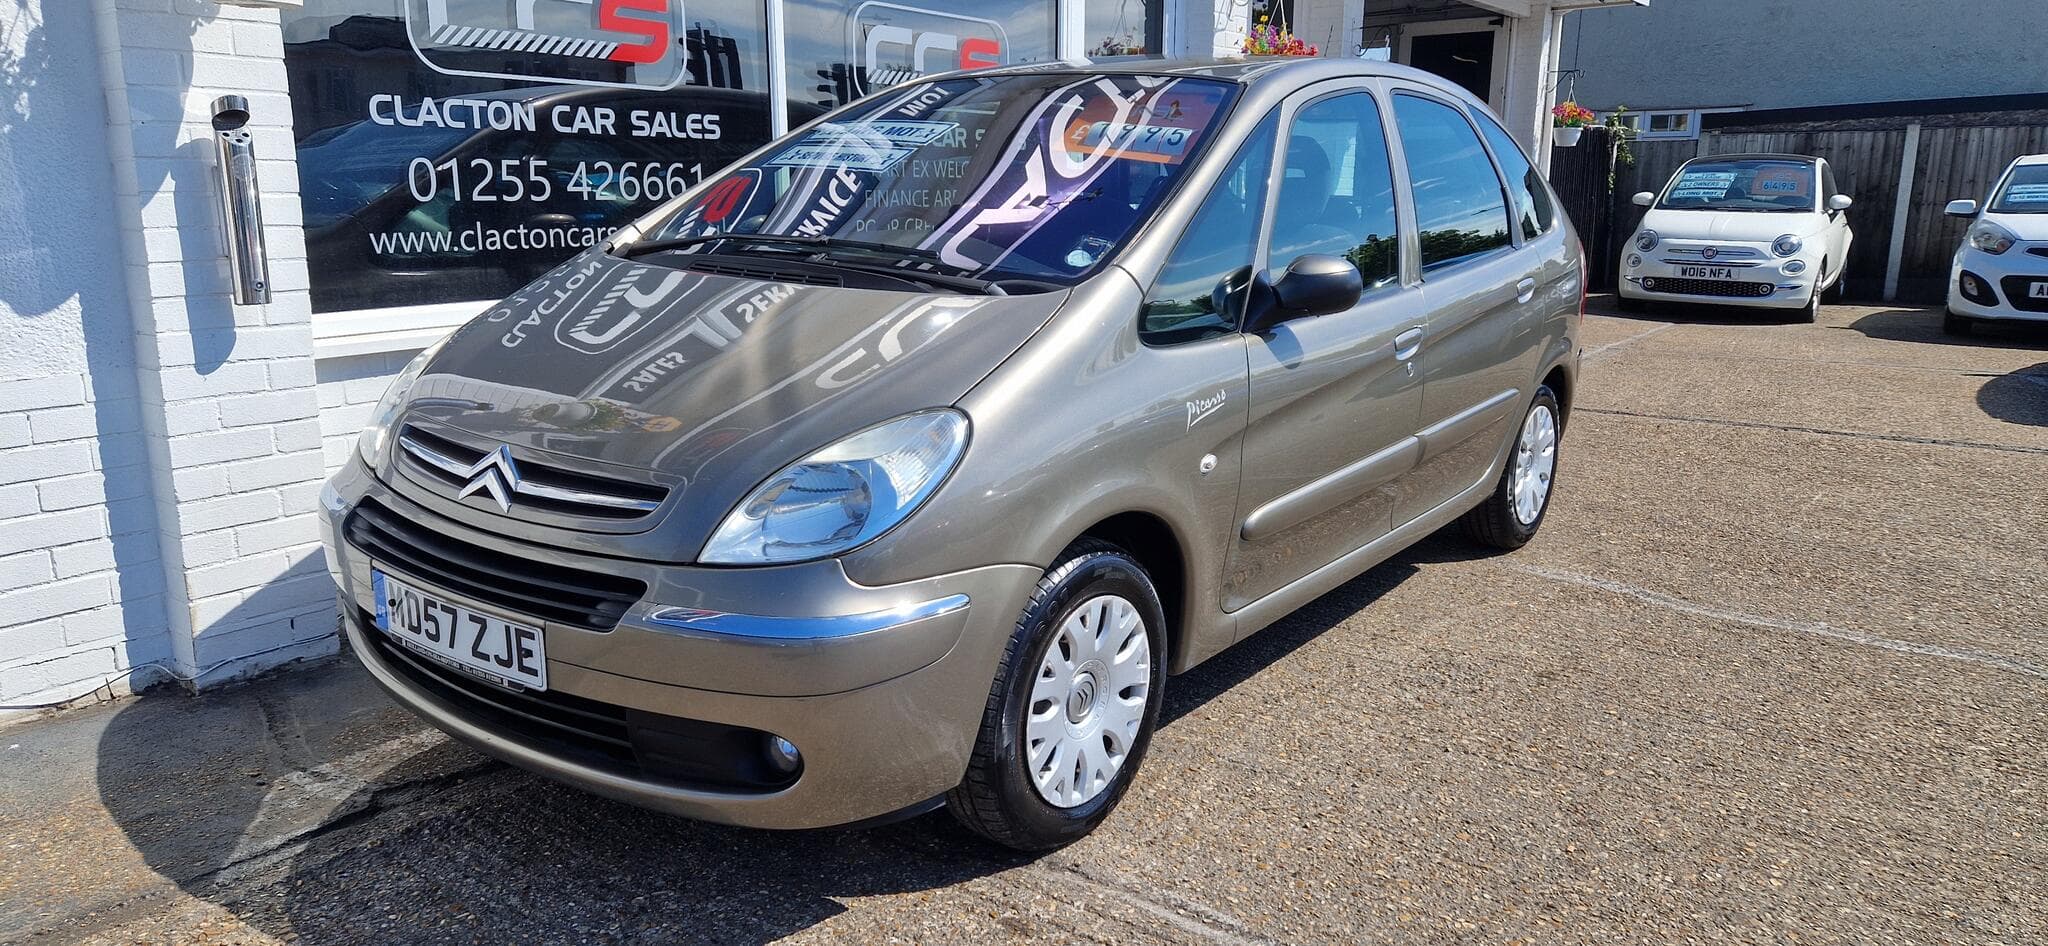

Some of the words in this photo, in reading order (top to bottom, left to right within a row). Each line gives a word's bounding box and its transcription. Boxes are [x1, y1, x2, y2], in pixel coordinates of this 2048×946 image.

[369, 94, 537, 132] CLACTON
[552, 105, 616, 136] CAR
[631, 110, 721, 140] SALES
[407, 157, 551, 202] 01255
[567, 161, 703, 201] 426661
[913, 160, 930, 178] EX
[865, 190, 930, 208] FINANCE
[1763, 182, 1796, 191] 6495
[1709, 269, 1732, 279] NFA
[1186, 389, 1226, 433] Picasso
[388, 581, 458, 649] MD57
[469, 613, 539, 677] ZJE
